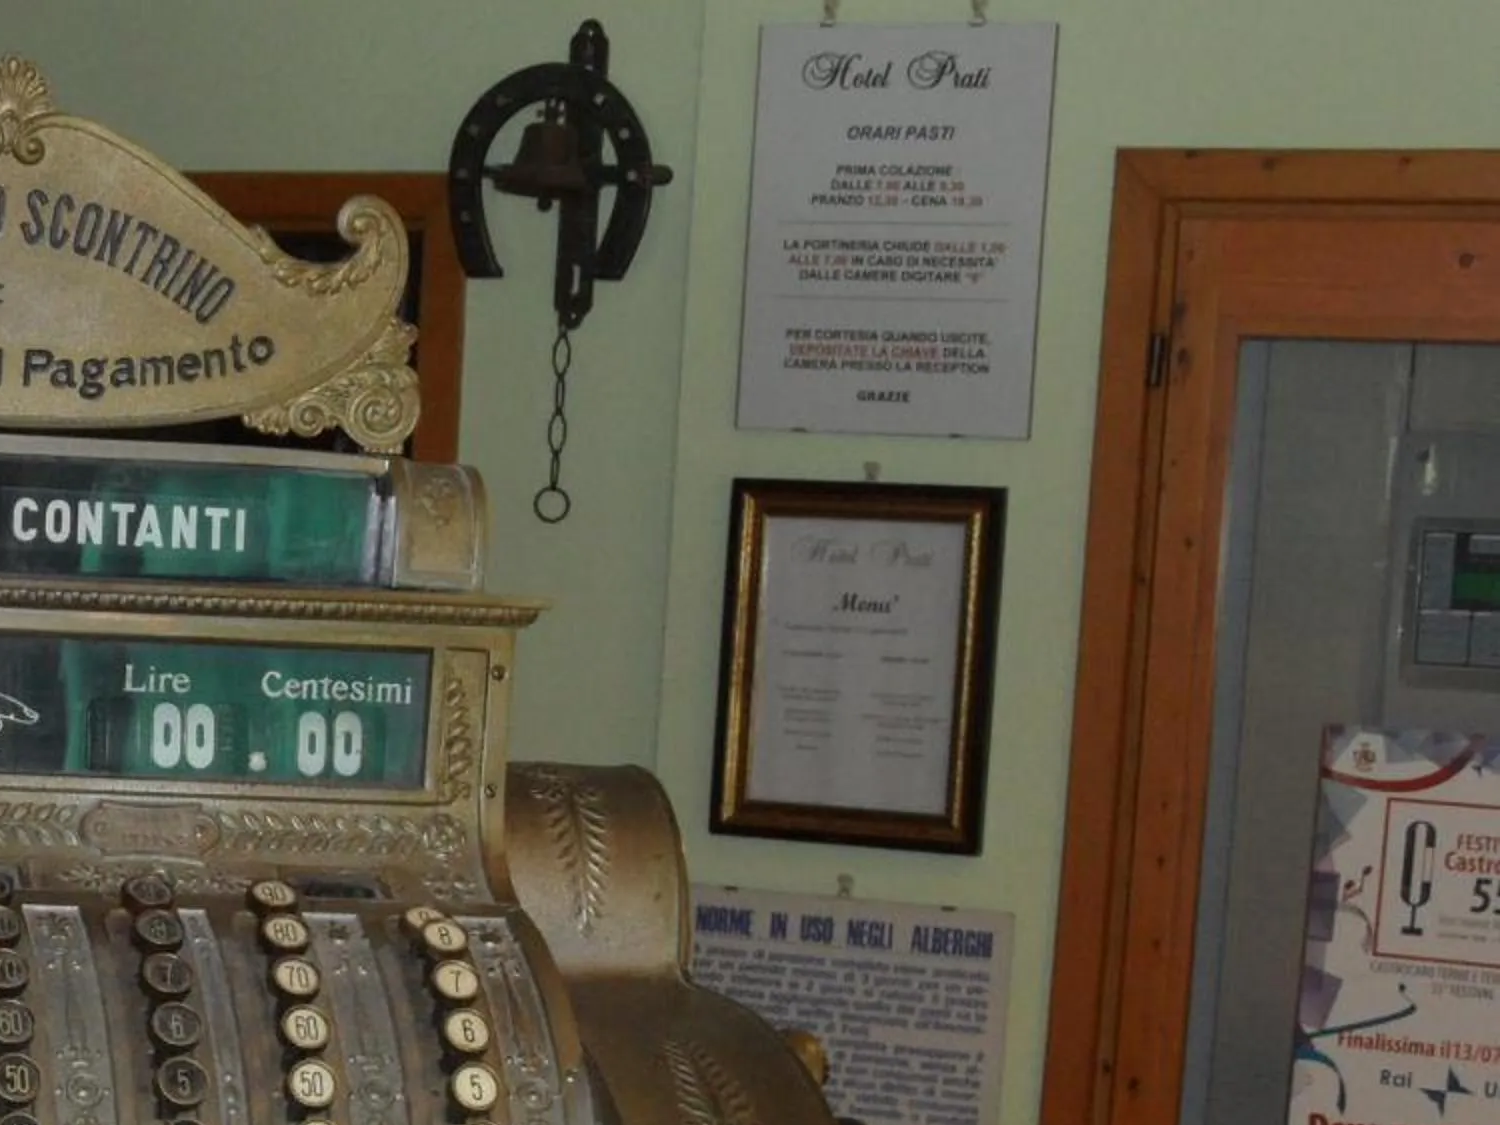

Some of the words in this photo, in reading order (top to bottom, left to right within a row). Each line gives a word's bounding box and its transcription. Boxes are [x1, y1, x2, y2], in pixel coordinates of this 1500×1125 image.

[802, 51, 892, 90] Hotel
[906, 50, 991, 90] Prati
[847, 126, 901, 141] ORARI
[905, 126, 955, 141] PASTI
[836, 164, 876, 176] PRIMA
[879, 164, 952, 177] COLAZIONE
[831, 179, 871, 191] DALLE
[903, 180, 935, 192] ALLE
[811, 194, 864, 207] PRANZO
[911, 195, 947, 208] CENA
[19, 188, 237, 326] SCONTRINO
[783, 239, 799, 251] LA
[799, 268, 841, 281] DALLE
[22, 335, 276, 400] Pagamento
[856, 390, 911, 403] GRAZIE
[12, 497, 247, 553] CONTANTI
[123, 663, 192, 695] Lire
[261, 670, 413, 706] Centesimi
[151, 701, 216, 770] 00
[296, 710, 363, 777] 00
[1456, 832, 1500, 854] FESTI
[260, 884, 287, 902] 90
[273, 921, 298, 943] 80
[437, 926, 453, 946] 8
[695, 904, 753, 939] NORME
[769, 911, 787, 940] IN
[800, 914, 834, 944] USO
[846, 918, 893, 951] NEGLI
[910, 924, 993, 959] ALBERGHI
[283, 965, 309, 989] 70
[448, 970, 462, 993] 7
[170, 1012, 184, 1040] 6
[295, 1014, 319, 1041] 60
[461, 1017, 476, 1044] 6
[1337, 1030, 1435, 1058] Finalissima
[5, 1065, 29, 1093] 50
[175, 1068, 192, 1097] 5
[300, 1069, 325, 1098] 50
[469, 1073, 484, 1102] 5
[1379, 1068, 1413, 1089] Rai
